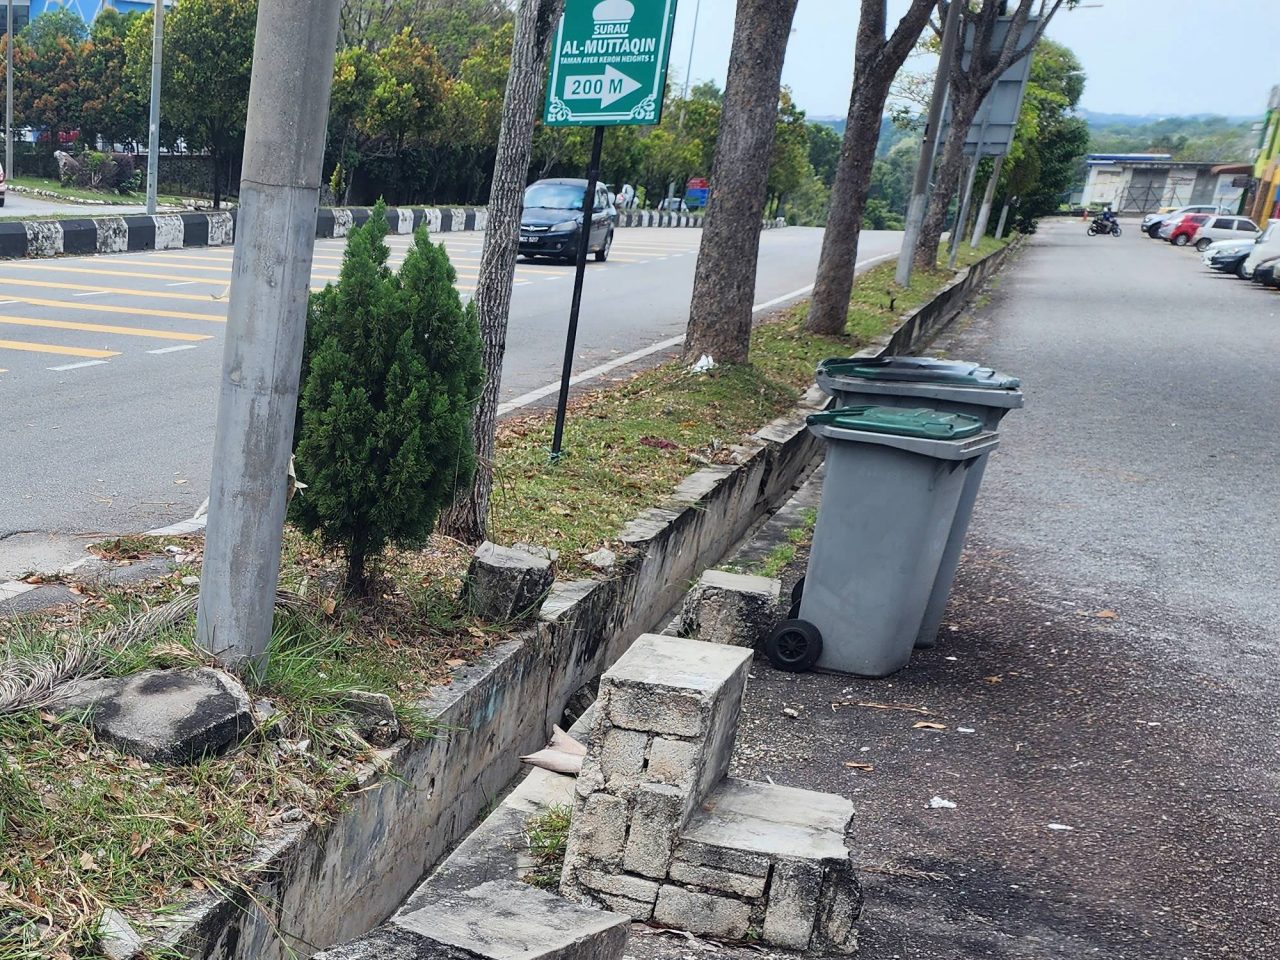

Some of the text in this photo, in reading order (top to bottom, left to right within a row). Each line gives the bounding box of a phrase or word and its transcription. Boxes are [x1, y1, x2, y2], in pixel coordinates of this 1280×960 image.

[593, 24, 628, 34] SURAU
[562, 38, 655, 54] AL-MUTTAQIN
[582, 56, 599, 64] AYER
[599, 55, 621, 63] KEROH
[621, 55, 650, 63] HEIGHTS
[571, 78, 623, 95] 200 M
